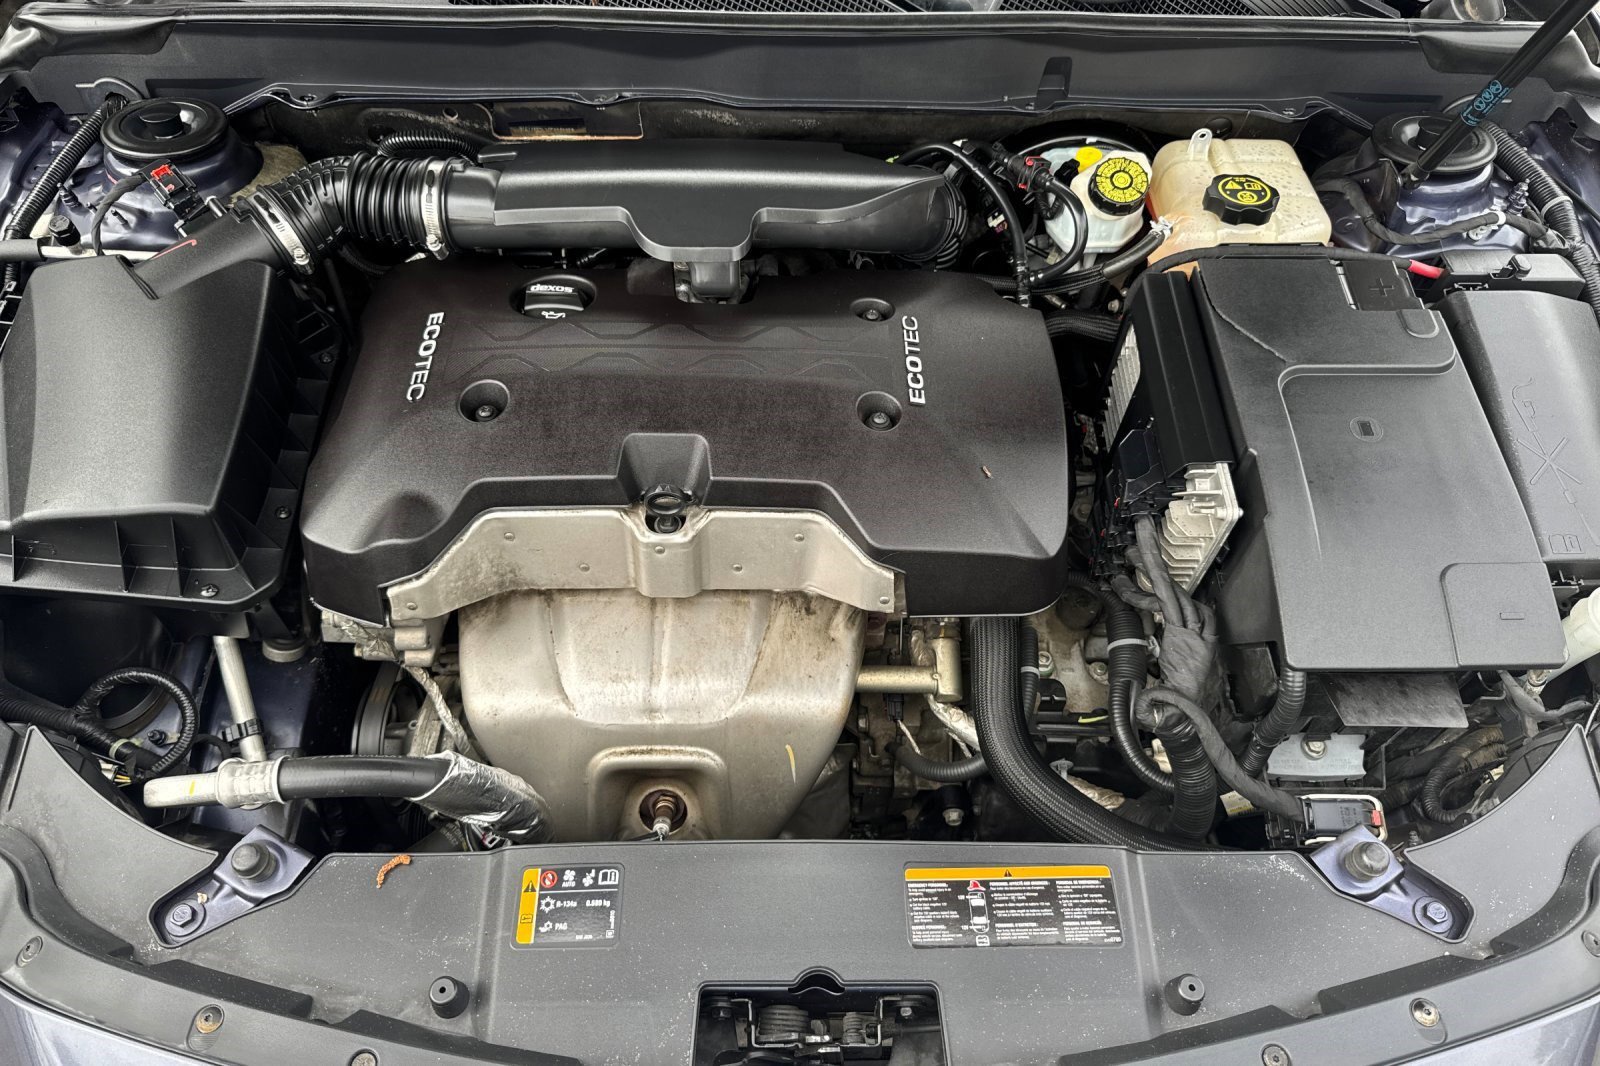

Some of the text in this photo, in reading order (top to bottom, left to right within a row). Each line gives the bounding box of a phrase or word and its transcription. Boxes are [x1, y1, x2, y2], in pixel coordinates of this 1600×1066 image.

[530, 283, 574, 293] dexos
[406, 312, 444, 401] ECOTEC
[902, 315, 926, 404] ECOTEC
[556, 900, 577, 908] R-134a
[554, 922, 568, 930] PAG
